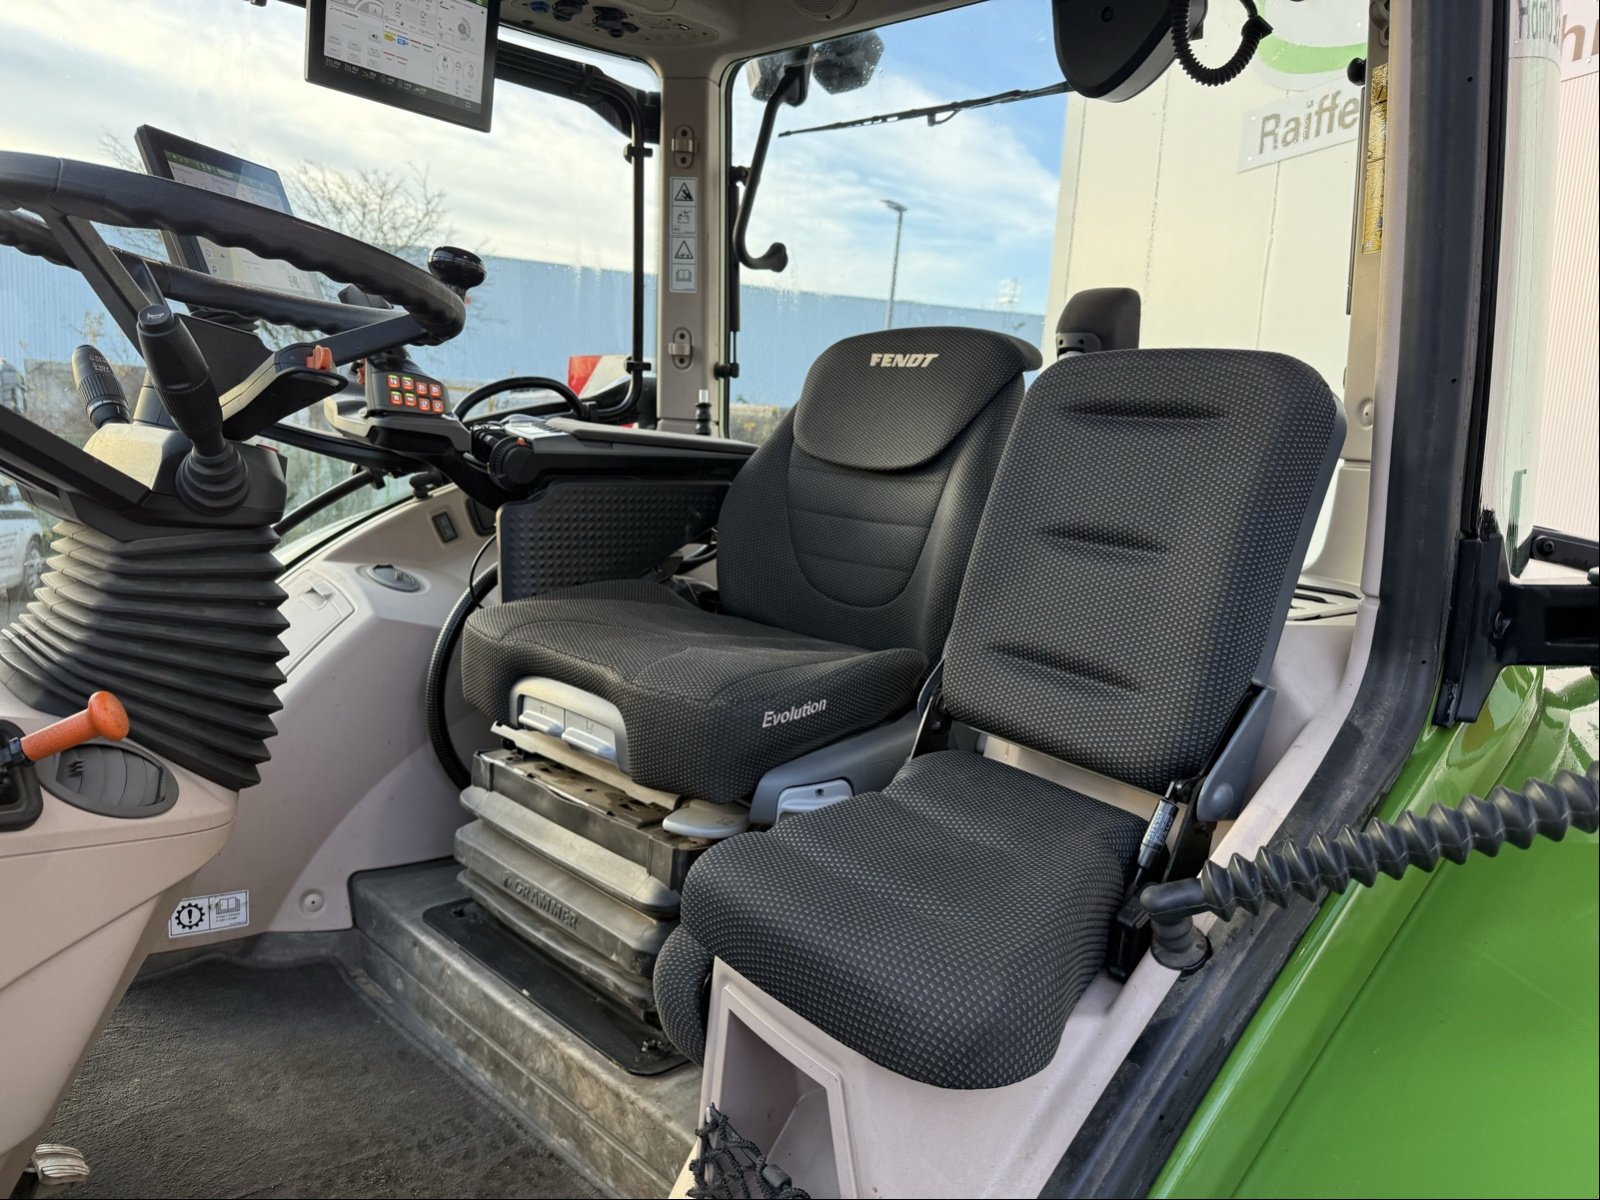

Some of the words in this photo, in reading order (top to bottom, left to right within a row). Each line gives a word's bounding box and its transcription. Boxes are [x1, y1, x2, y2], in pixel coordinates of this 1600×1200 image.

[1258, 89, 1360, 155] Raiffe
[869, 352, 940, 368] FENDT
[761, 698, 828, 729] Evolution
[514, 879, 579, 931] GRAMMER
